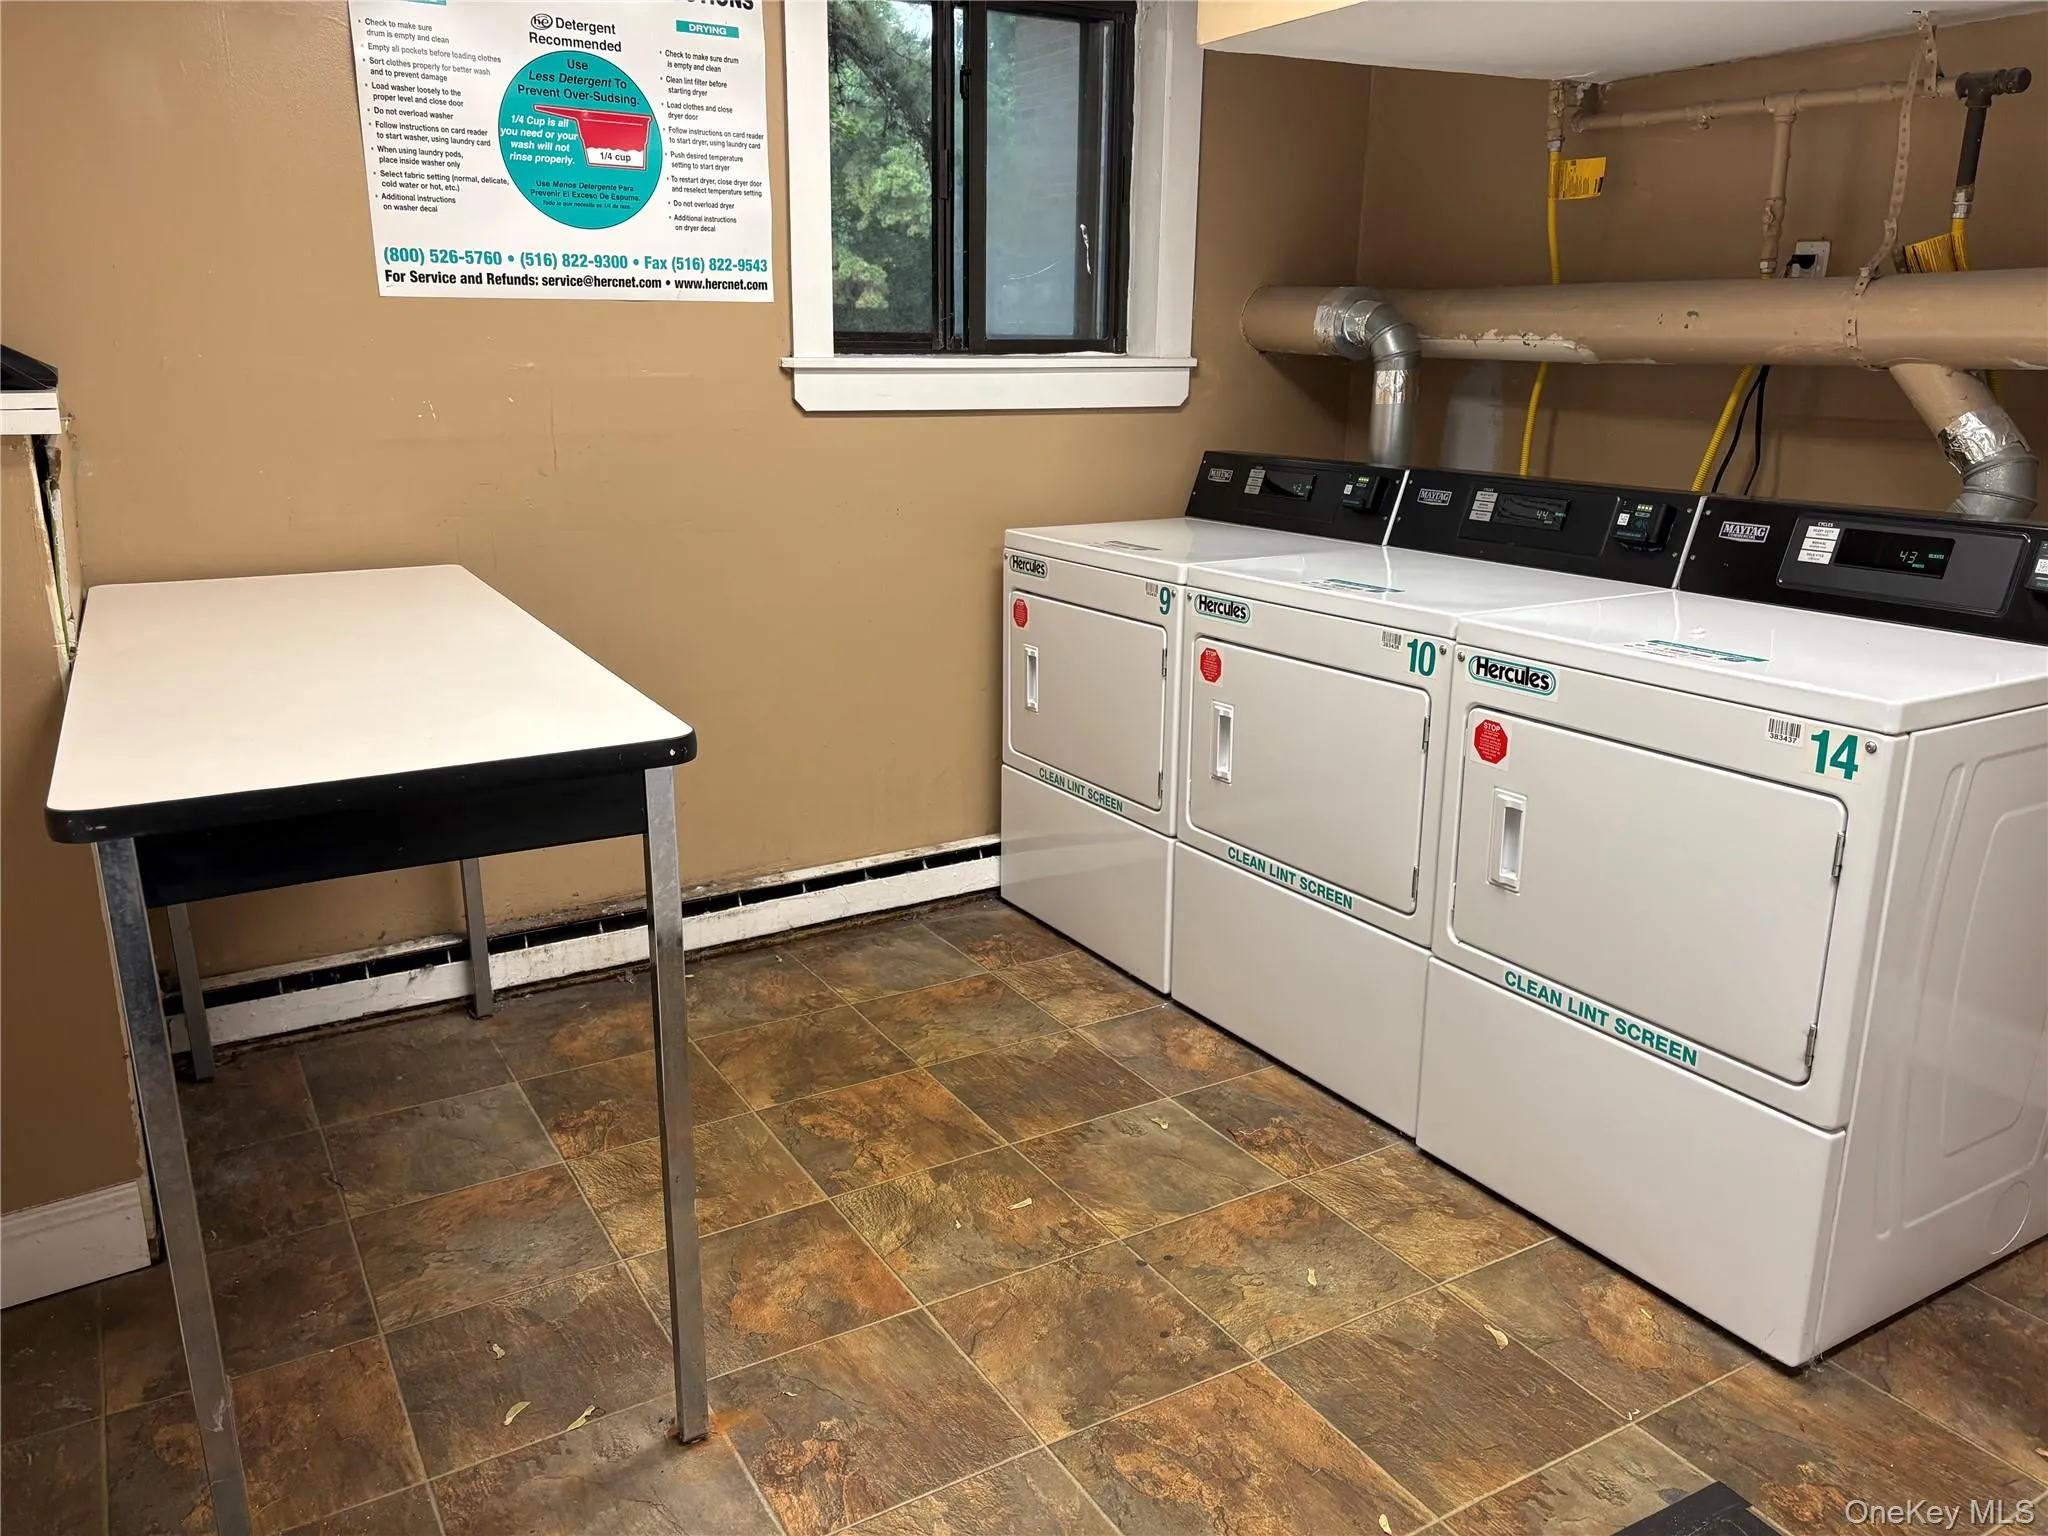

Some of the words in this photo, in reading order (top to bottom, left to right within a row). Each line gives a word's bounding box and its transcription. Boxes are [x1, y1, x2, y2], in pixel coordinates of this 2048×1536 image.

[364, 18, 387, 27] Check
[388, 20, 396, 28] to
[397, 22, 416, 30] make
[555, 17, 616, 35] Detergent
[688, 23, 727, 35] DRYING
[366, 29, 385, 38] drum
[394, 33, 416, 41] empty
[431, 36, 450, 44] clean
[528, 31, 622, 52] Recommended
[567, 58, 589, 71] Use
[528, 70, 555, 82] Less
[558, 73, 612, 88] Detergent
[614, 78, 627, 89] To
[371, 82, 389, 90] Load
[390, 84, 415, 92] washer
[416, 85, 441, 96] loosely
[442, 87, 449, 95] to
[450, 88, 461, 96] the
[517, 84, 560, 97] Prevent
[563, 88, 640, 107] Over-Sudsing.
[372, 93, 396, 102] proper
[397, 95, 413, 103] level
[448, 99, 464, 107] door
[667, 101, 681, 109] Load
[682, 103, 704, 111] clothes
[398, 109, 428, 118] overload
[429, 111, 453, 120] washer
[511, 114, 525, 125] 1/4
[526, 116, 545, 127] Cup
[547, 117, 556, 127] is
[557, 118, 569, 128] all
[667, 111, 683, 120] dryer
[375, 120, 398, 130] Follow
[399, 122, 439, 132] instructions
[440, 125, 449, 133] on
[450, 126, 465, 134] card
[467, 128, 488, 136] reader
[500, 128, 518, 137] you
[520, 129, 543, 138] need
[545, 131, 556, 139] or
[557, 131, 578, 141] your
[376, 131, 384, 139] to
[385, 132, 402, 140] start
[403, 134, 430, 142] washer,
[431, 136, 449, 144] using
[450, 136, 475, 146] laundry
[476, 139, 491, 147] card
[510, 140, 535, 149] wash
[537, 141, 552, 150] will
[555, 143, 570, 152] not
[376, 145, 397, 153] When
[398, 147, 417, 156] using
[418, 148, 443, 158] laundry
[445, 150, 464, 159] pods,
[509, 153, 532, 161] rinse
[534, 154, 575, 165] properly.
[600, 152, 612, 161] 1/4
[615, 154, 631, 163] cup
[379, 156, 398, 164] place
[399, 157, 420, 165] inside
[421, 158, 445, 167] washer
[447, 160, 460, 169] only
[380, 170, 402, 178] Select
[426, 173, 450, 182] setting
[451, 175, 480, 184] (normal,
[480, 177, 509, 185] delicate,
[381, 180, 397, 188] cold
[398, 181, 419, 189] water
[429, 183, 444, 191] hot,
[445, 184, 460, 193] etc.)
[552, 181, 577, 189] Menos
[578, 182, 617, 191] Detergente
[381, 193, 416, 202] Additional
[417, 195, 456, 203] instructions
[530, 188, 561, 197] Prevenir
[571, 190, 597, 199] Exceso
[599, 192, 610, 200] De
[611, 193, 640, 202] Espuma.
[393, 204, 418, 212] washer
[673, 199, 682, 207] Do
[694, 201, 718, 209] overload
[719, 202, 734, 210] dryer
[674, 214, 702, 222] Additional
[704, 215, 737, 223] instructions
[683, 224, 699, 232] dryer
[383, 246, 425, 266] (800)
[429, 249, 502, 265] 526-5760
[520, 251, 557, 270] (516)
[562, 253, 628, 269] 822-9300
[644, 255, 667, 270] Fax
[671, 256, 705, 273] (516)
[709, 257, 767, 272] 822-9543
[385, 269, 406, 283] For
[410, 270, 456, 284] Service
[460, 273, 483, 285] and
[486, 273, 539, 286] Refunds:
[542, 274, 661, 288] service@hercnet.com
[674, 278, 768, 290] www.hercnet.com
[1420, 490, 1449, 501] MAYTAG
[1723, 523, 1766, 537] MAYTAG
[1900, 550, 1918, 564] 43
[1012, 555, 1046, 575] Hercules
[1159, 586, 1171, 615] 9
[1199, 595, 1246, 620] Hercules
[1407, 638, 1436, 676] 10
[1475, 656, 1550, 691] Hercules
[1483, 721, 1500, 732] STOP
[1769, 732, 1797, 744] 383437
[1810, 729, 1858, 780] 14
[1039, 767, 1065, 787] CLEAN
[1067, 779, 1085, 796] LINT
[1087, 788, 1123, 812] SCREEN
[1228, 846, 1265, 873] CLEAN
[1269, 863, 1296, 885] LINT
[1300, 877, 1352, 909] SCREEN
[1504, 971, 1562, 1008] CLEAN
[1567, 997, 1609, 1027] LINT
[1614, 1017, 1697, 1066] SCREEN
